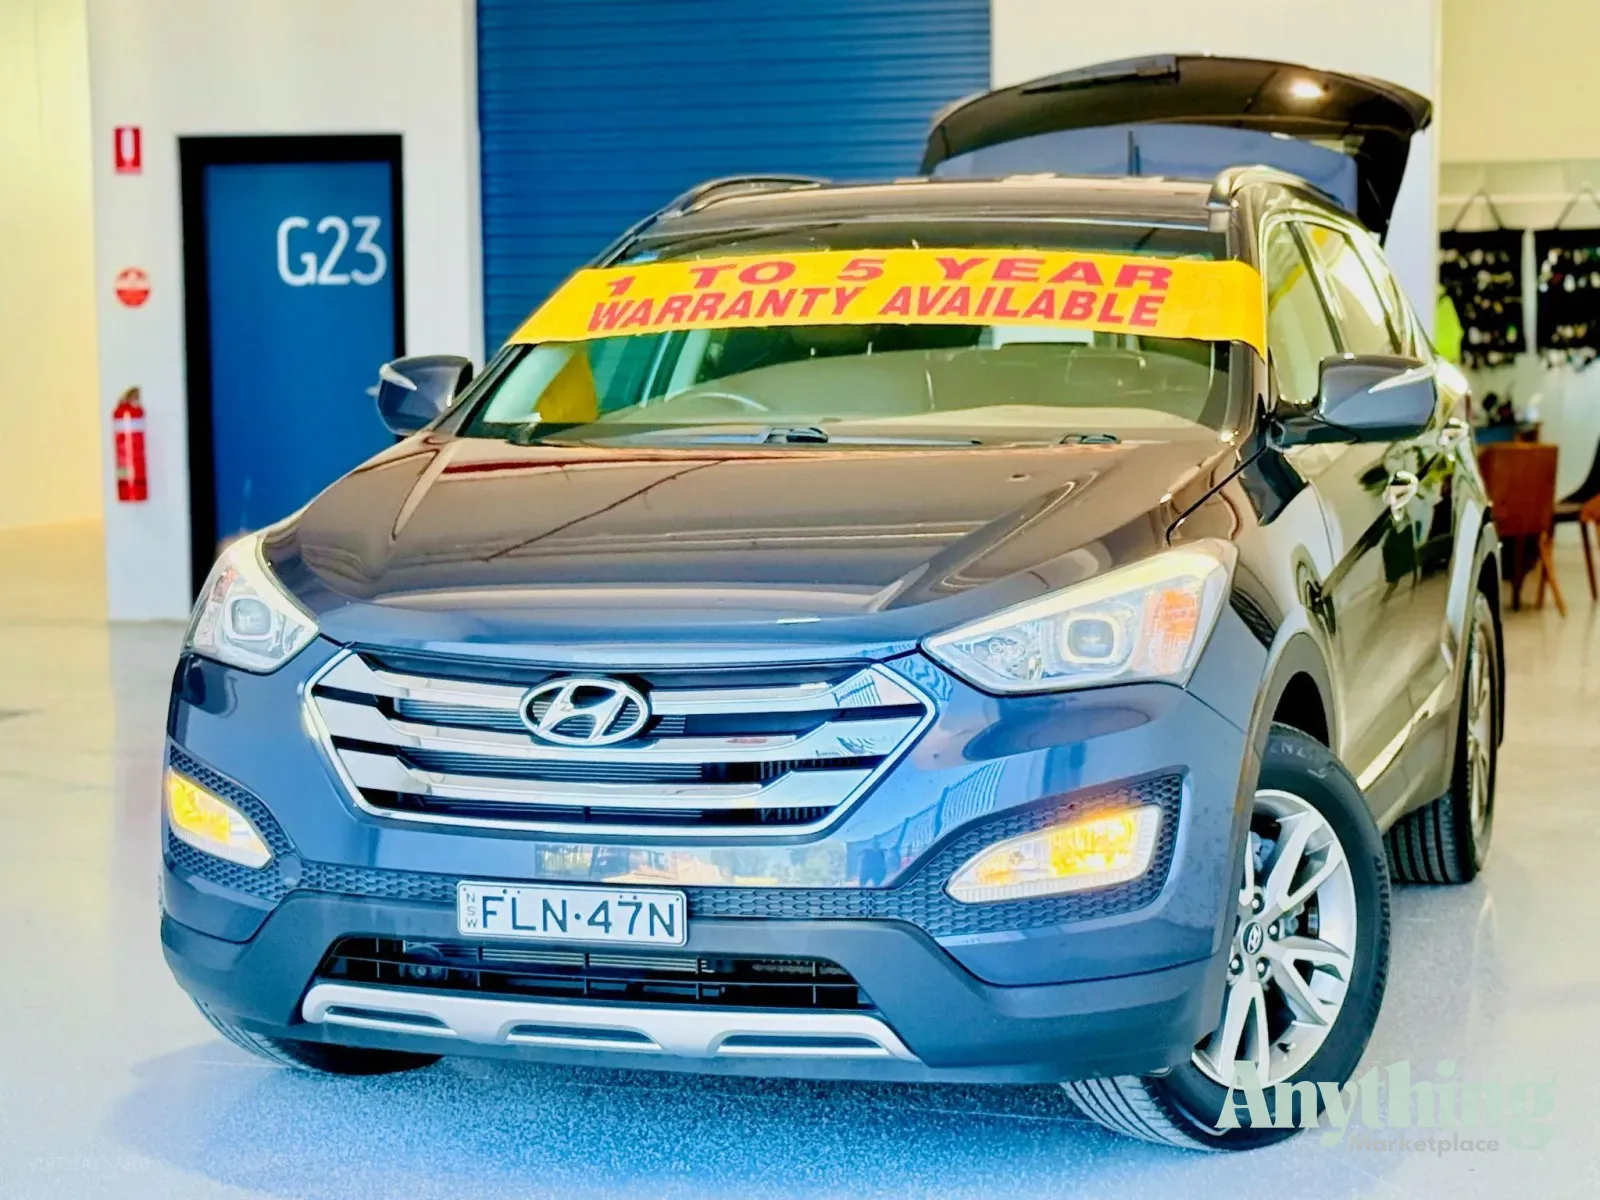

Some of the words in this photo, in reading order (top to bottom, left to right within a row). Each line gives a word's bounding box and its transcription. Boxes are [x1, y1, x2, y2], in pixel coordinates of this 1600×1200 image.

[277, 216, 388, 286] G23
[606, 275, 637, 297] 1
[688, 261, 797, 289] TO
[836, 258, 886, 282] 5
[934, 257, 1175, 290] YEAR
[587, 286, 867, 332] WARRANTY
[877, 286, 1166, 328] AVAILABLE
